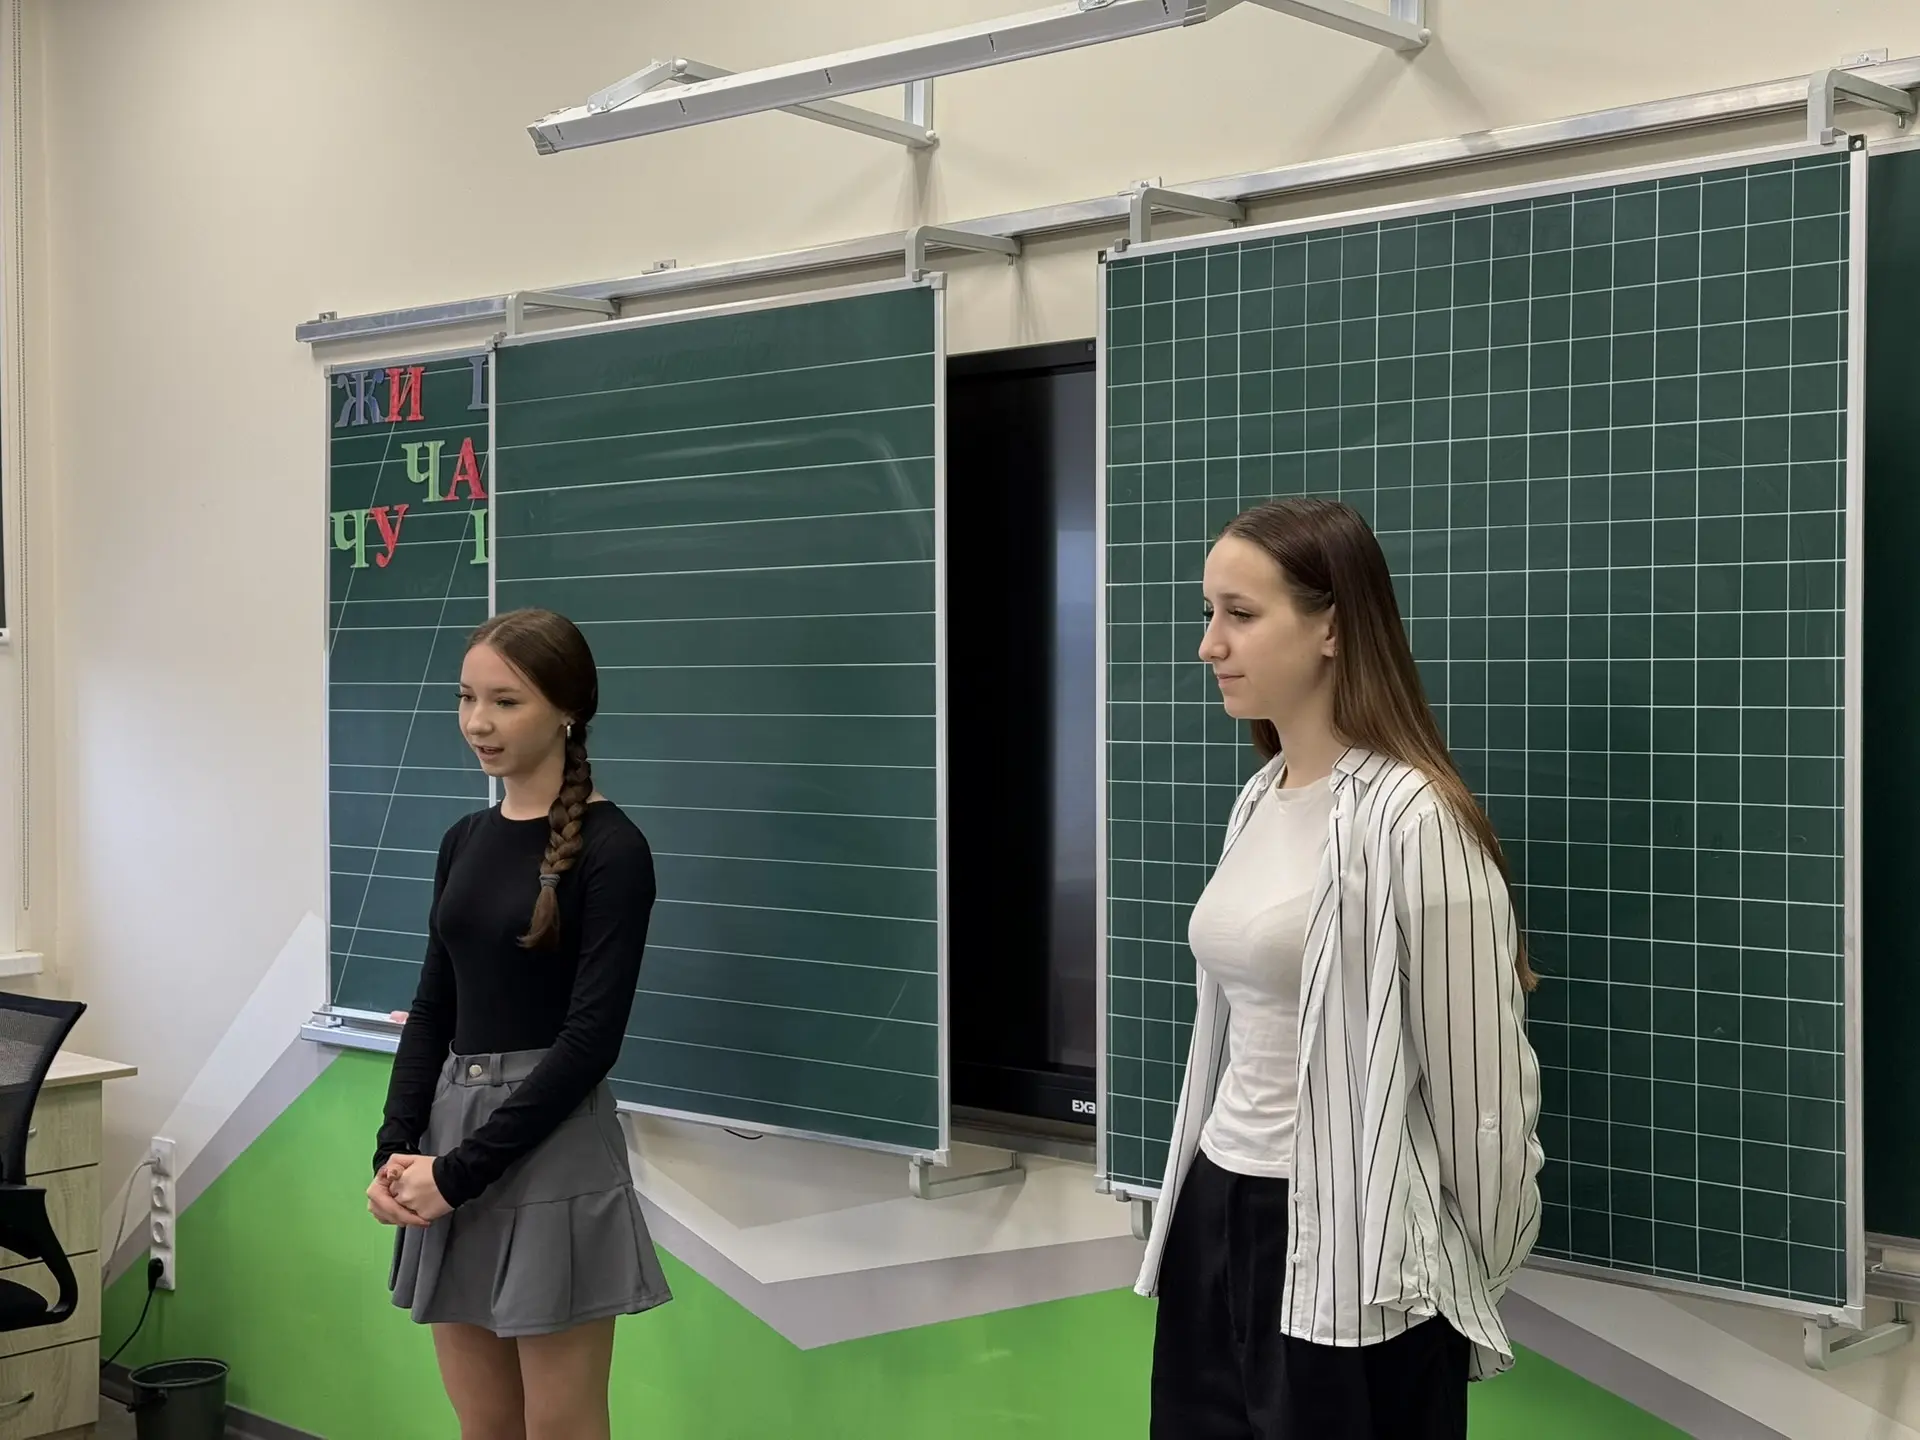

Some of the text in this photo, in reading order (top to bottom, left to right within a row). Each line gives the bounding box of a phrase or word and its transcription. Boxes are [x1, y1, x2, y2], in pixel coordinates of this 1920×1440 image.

[334, 366, 425, 428] ЖИ
[401, 437, 488, 503] ЧА
[330, 504, 410, 568] ЧУ
